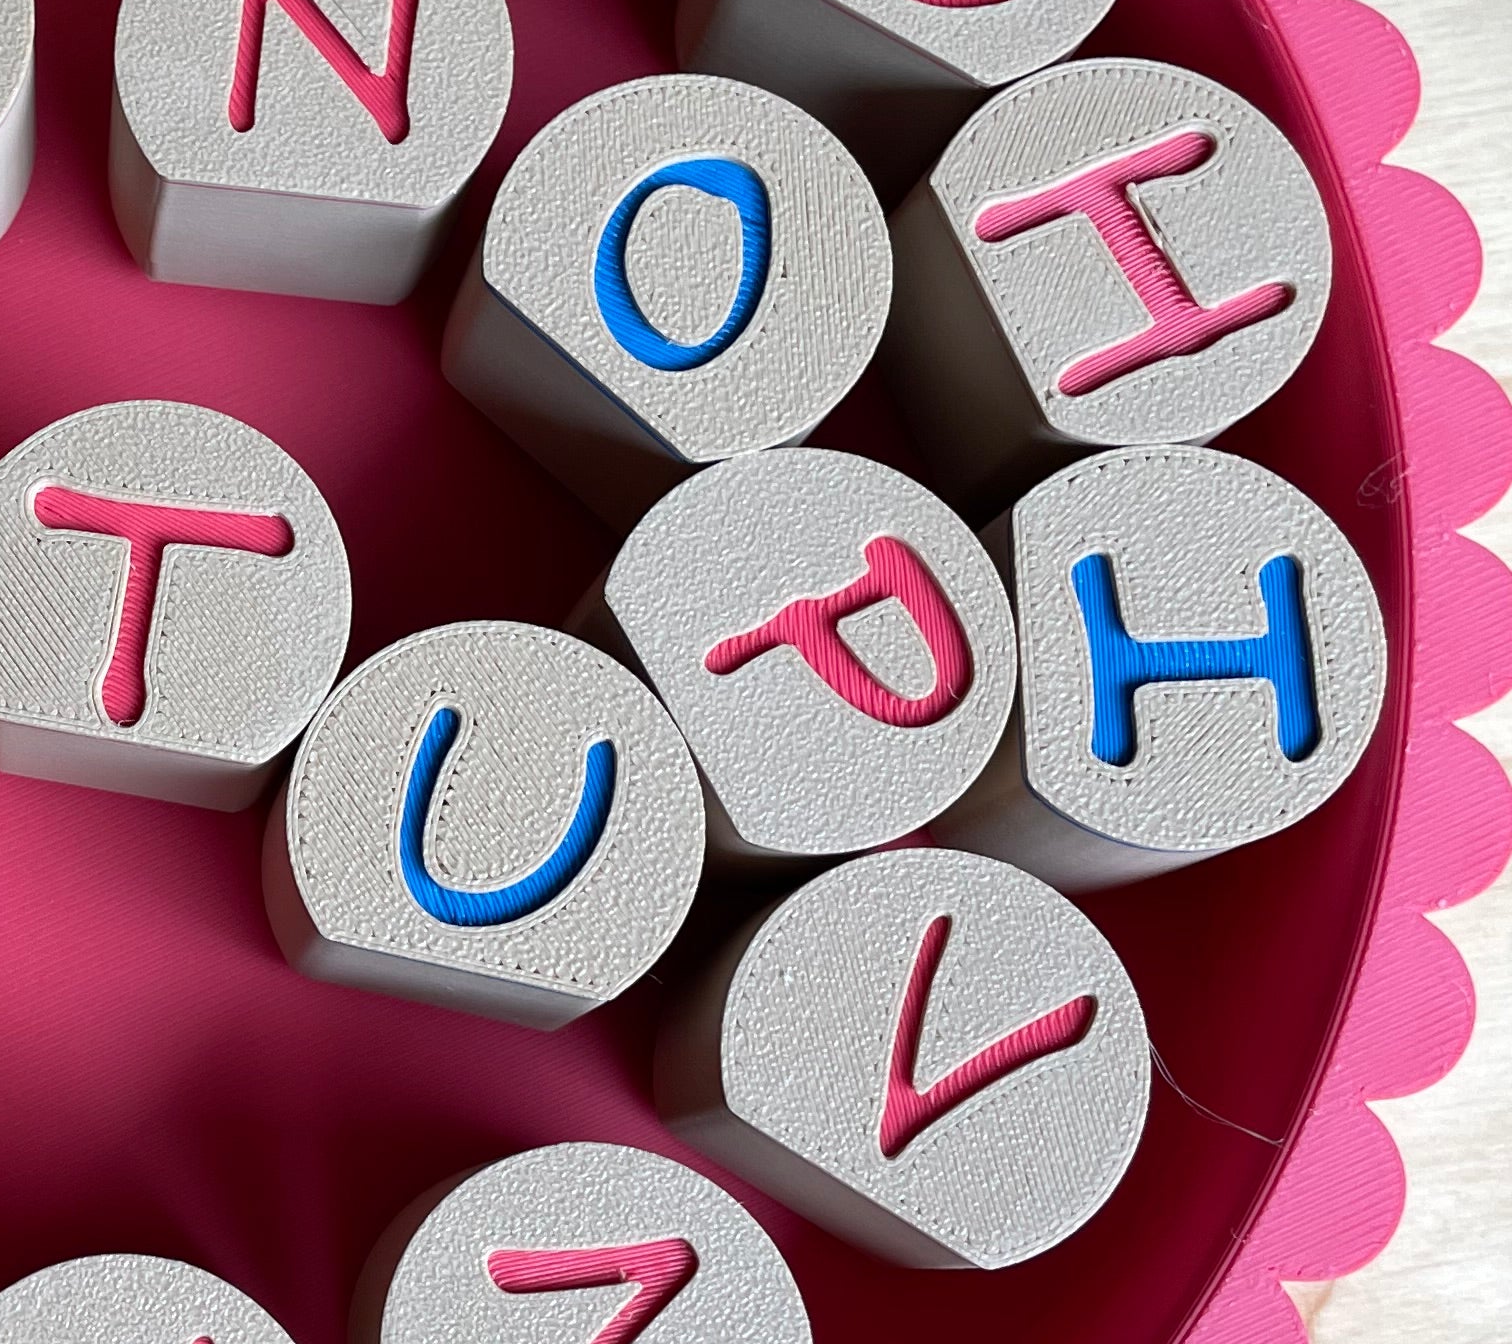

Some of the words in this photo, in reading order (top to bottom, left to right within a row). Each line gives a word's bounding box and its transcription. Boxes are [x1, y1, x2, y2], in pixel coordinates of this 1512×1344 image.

[594, 158, 767, 371] O
[34, 487, 294, 725] T
[705, 537, 973, 728] P
[400, 708, 612, 925] U
[880, 917, 1097, 1157] V
